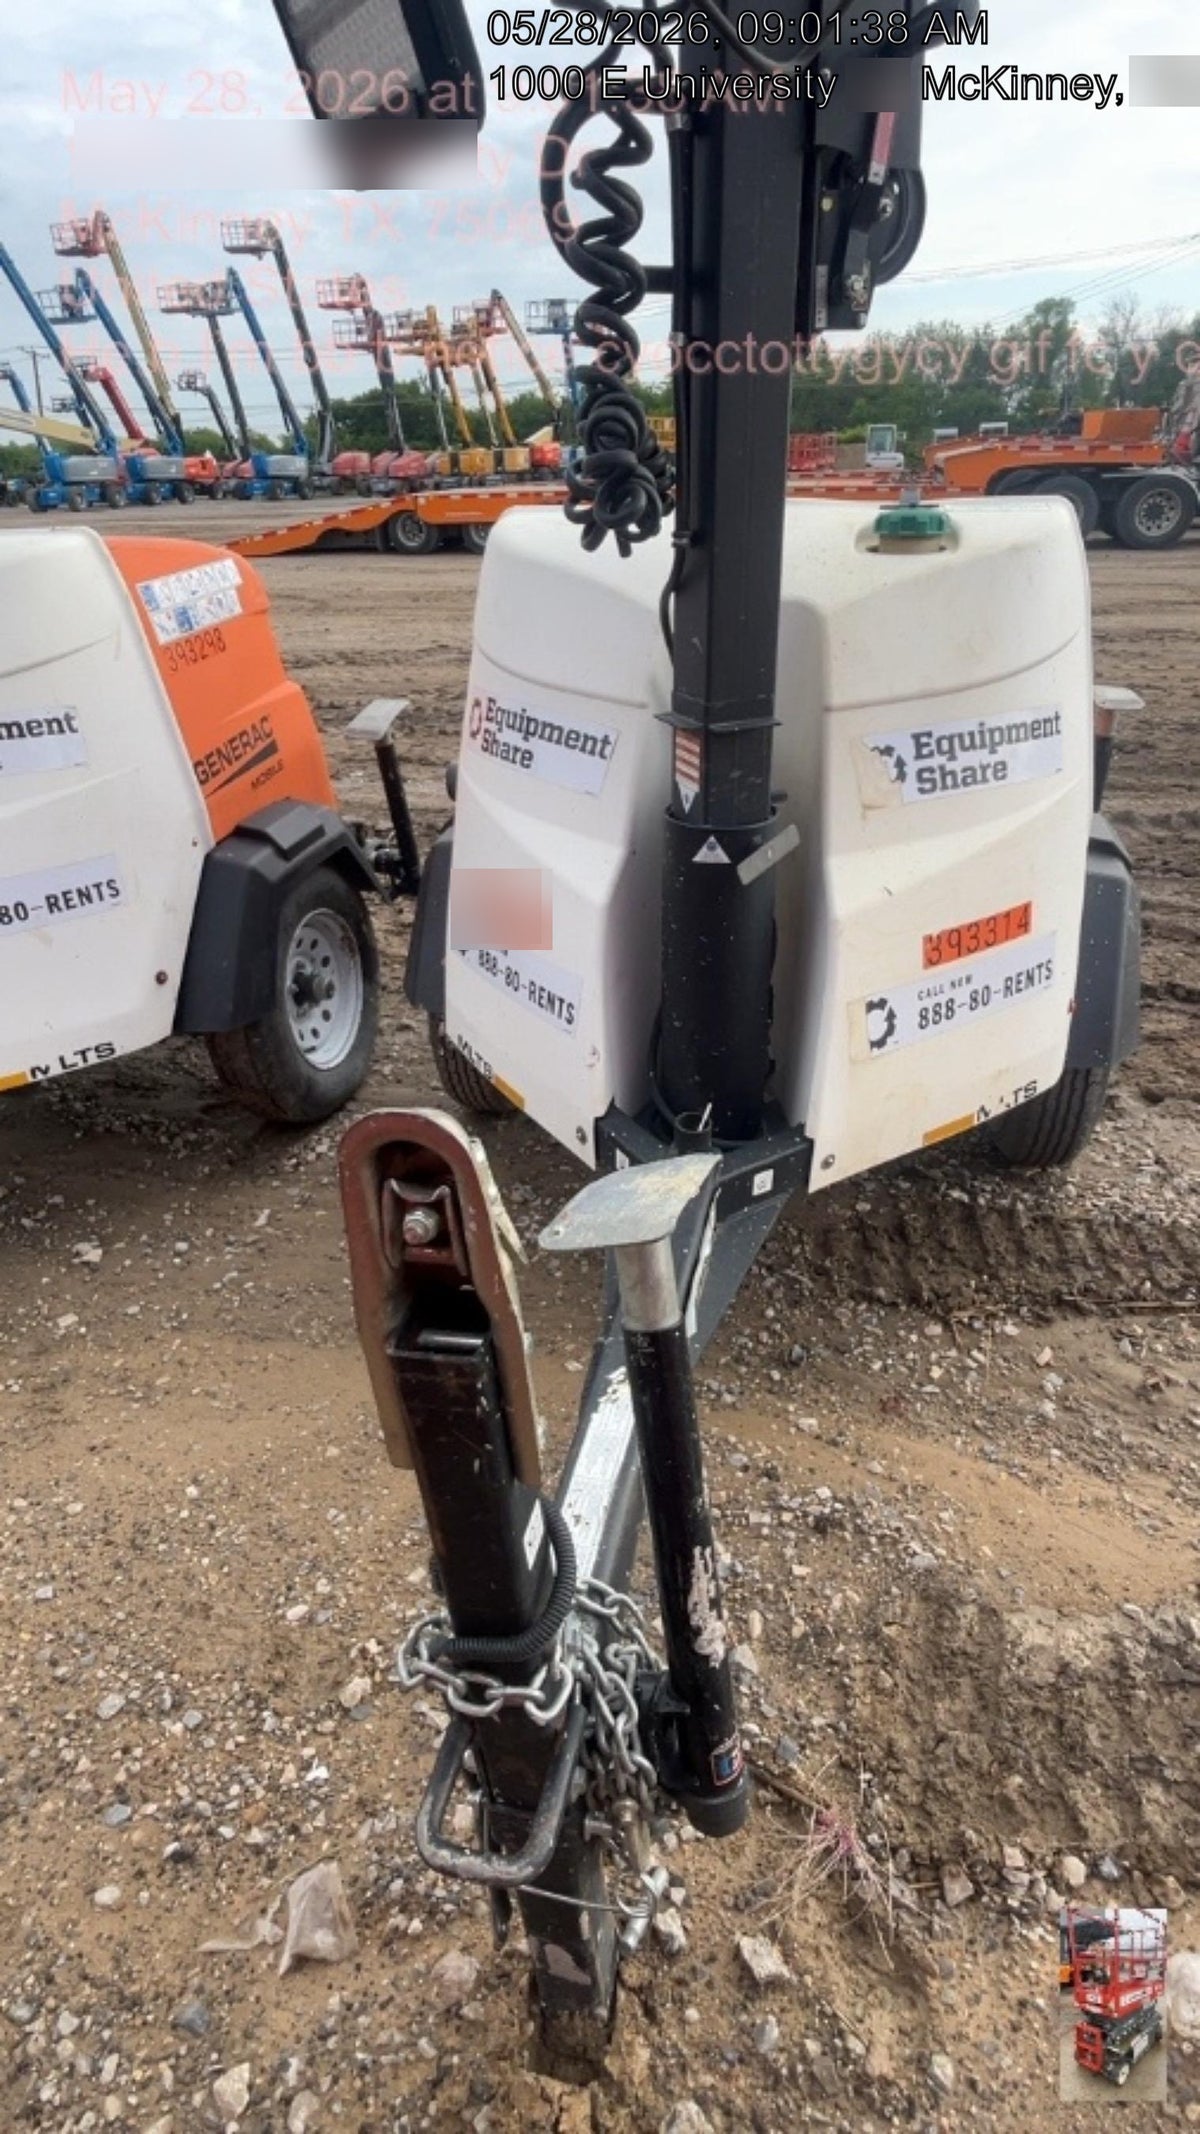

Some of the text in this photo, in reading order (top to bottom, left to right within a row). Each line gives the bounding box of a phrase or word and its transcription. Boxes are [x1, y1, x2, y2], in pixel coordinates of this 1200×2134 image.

[194, 715, 274, 786] GENERAC
[480, 727, 534, 769] Share
[484, 697, 612, 760] Equipment
[910, 711, 1060, 762] Equipment
[915, 758, 1007, 795] Share
[917, 984, 945, 1001] CALL
[917, 959, 1054, 1030] 888-80-RENTS
